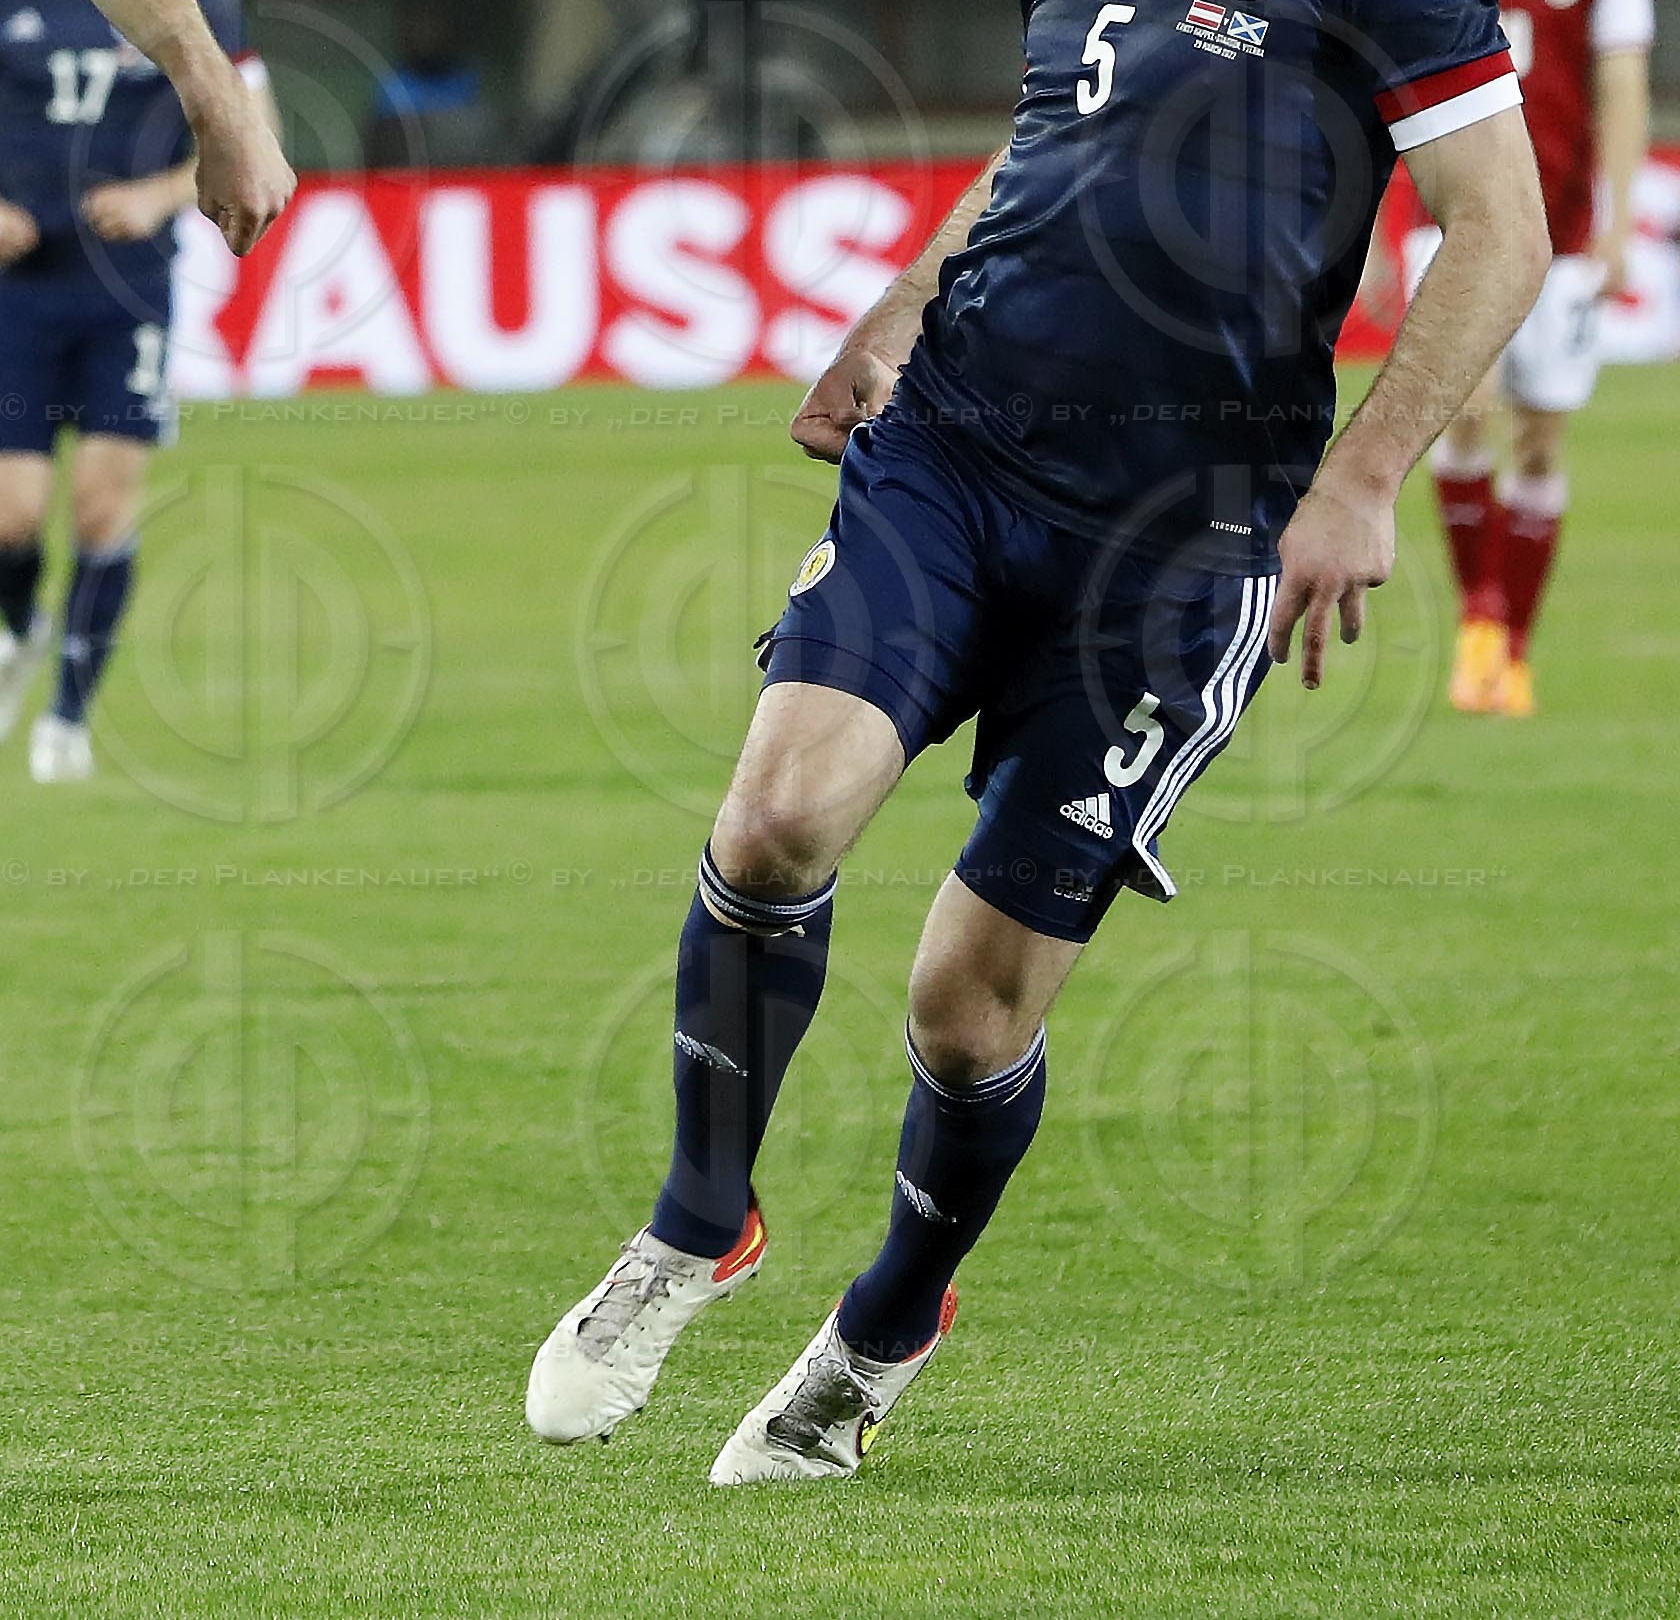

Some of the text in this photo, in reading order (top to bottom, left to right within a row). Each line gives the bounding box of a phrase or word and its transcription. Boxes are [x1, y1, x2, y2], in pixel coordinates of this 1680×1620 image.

[47, 47, 118, 125] 17
[1076, 2, 1137, 116] 5
[1103, 691, 1165, 788] 5
[1059, 804, 1114, 840] adidas
